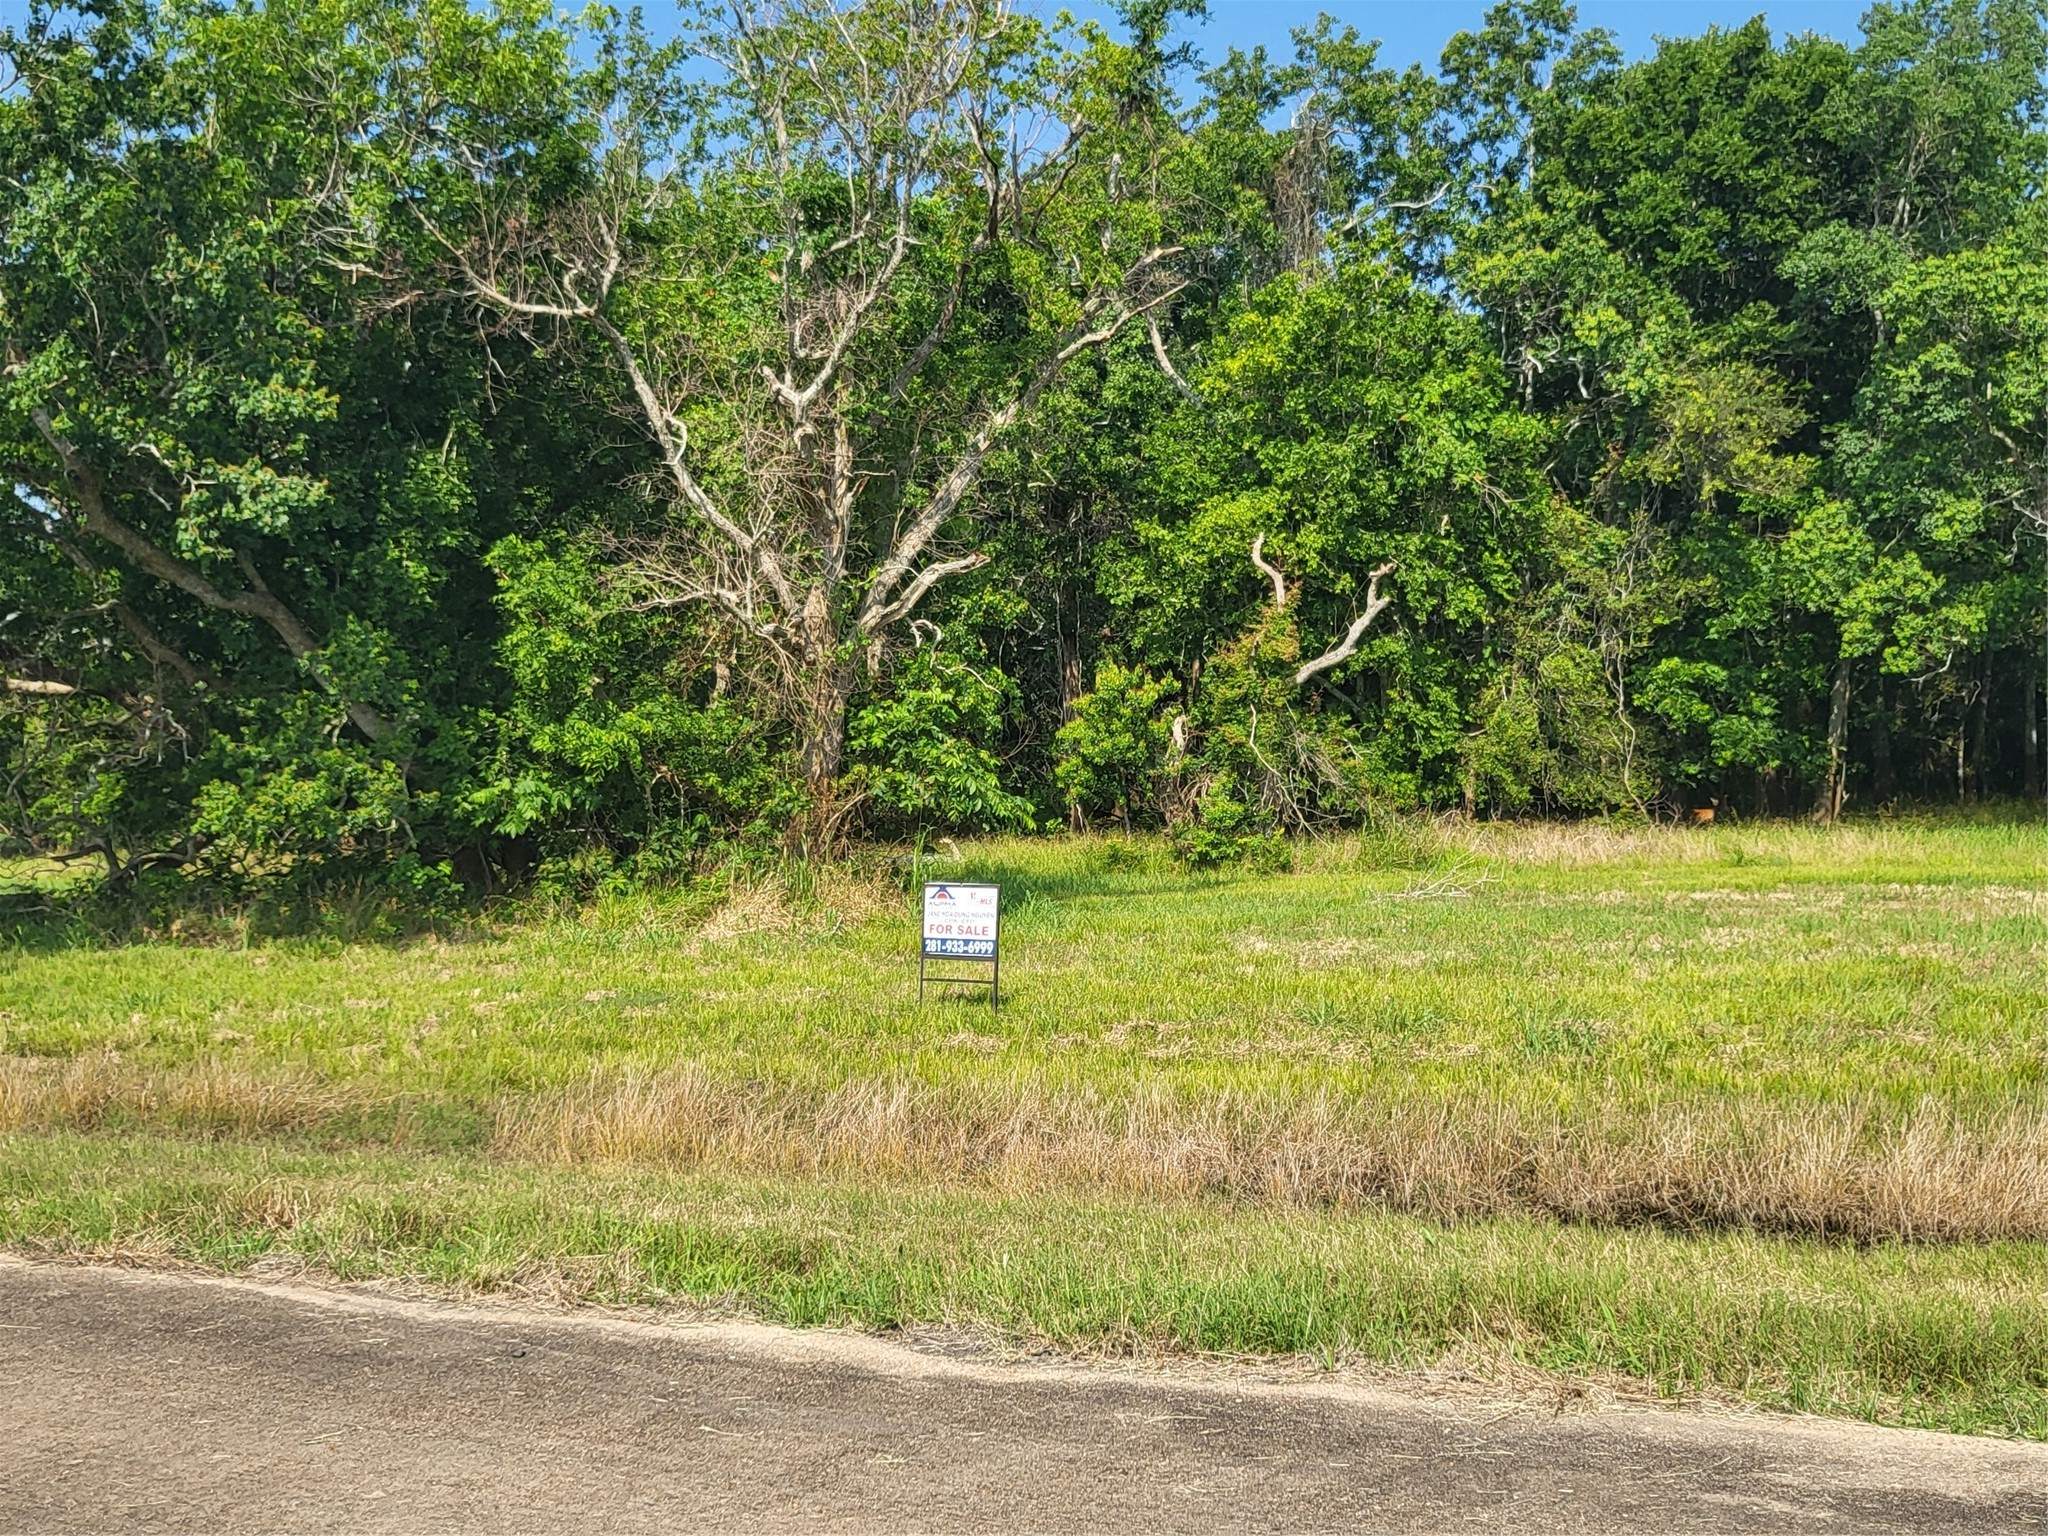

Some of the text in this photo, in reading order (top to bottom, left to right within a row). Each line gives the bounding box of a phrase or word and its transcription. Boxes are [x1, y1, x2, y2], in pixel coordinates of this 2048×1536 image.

[929, 924, 989, 936] FOR SALE
[925, 939, 994, 954] 281-933-6999
